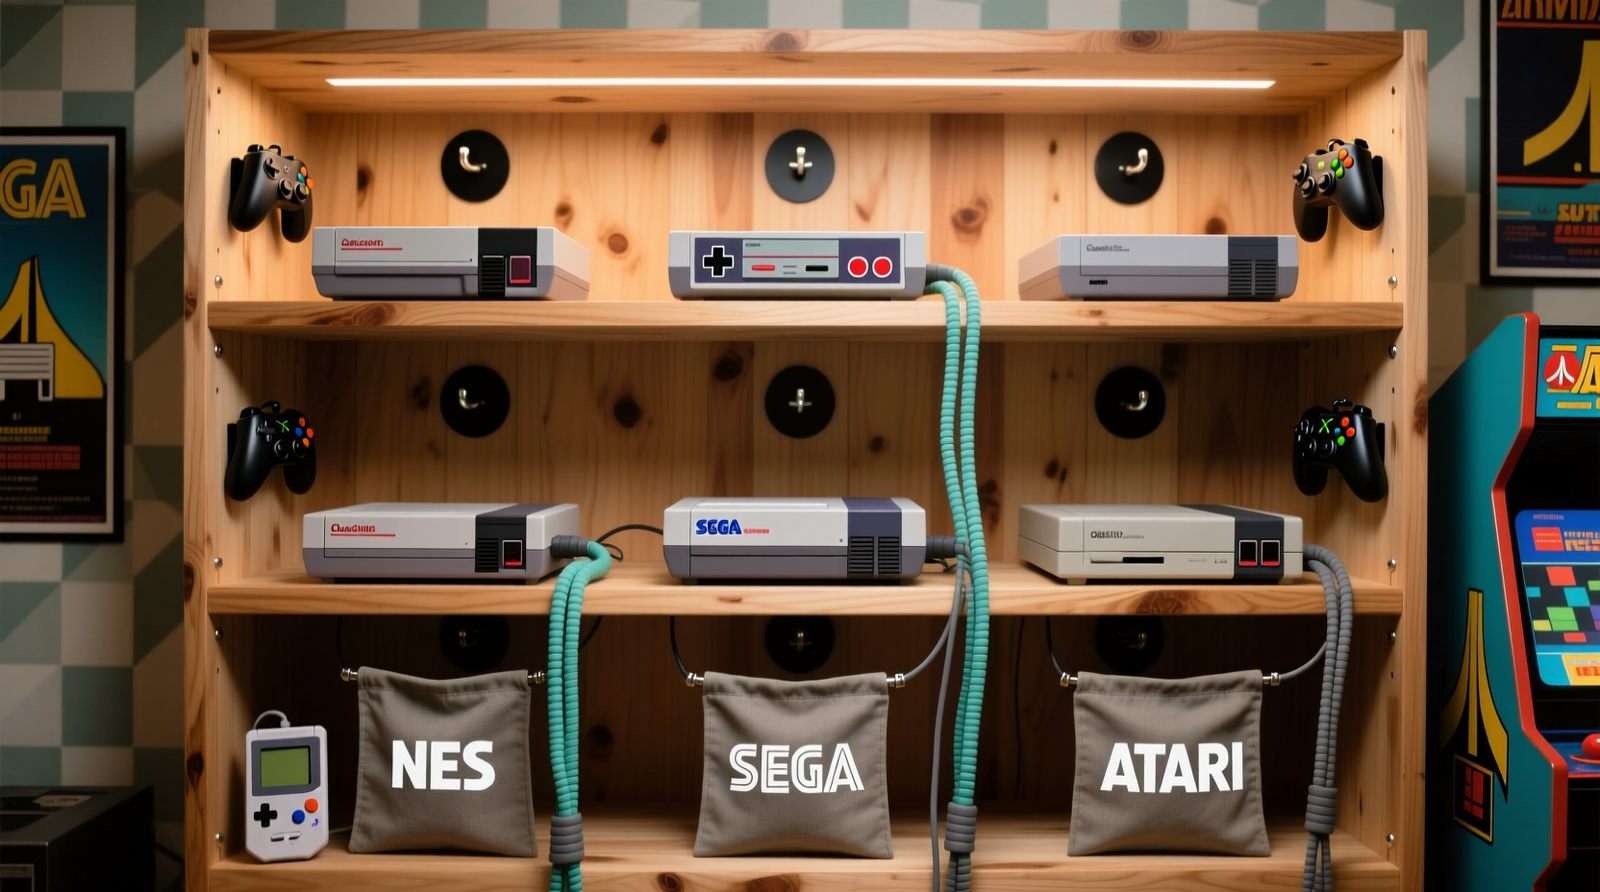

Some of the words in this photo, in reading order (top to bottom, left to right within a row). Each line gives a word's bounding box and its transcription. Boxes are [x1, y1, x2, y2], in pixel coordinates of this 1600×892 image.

[391, 740, 496, 791] NES
[729, 743, 865, 794] SEGA
[1100, 741, 1244, 793] ATARI
